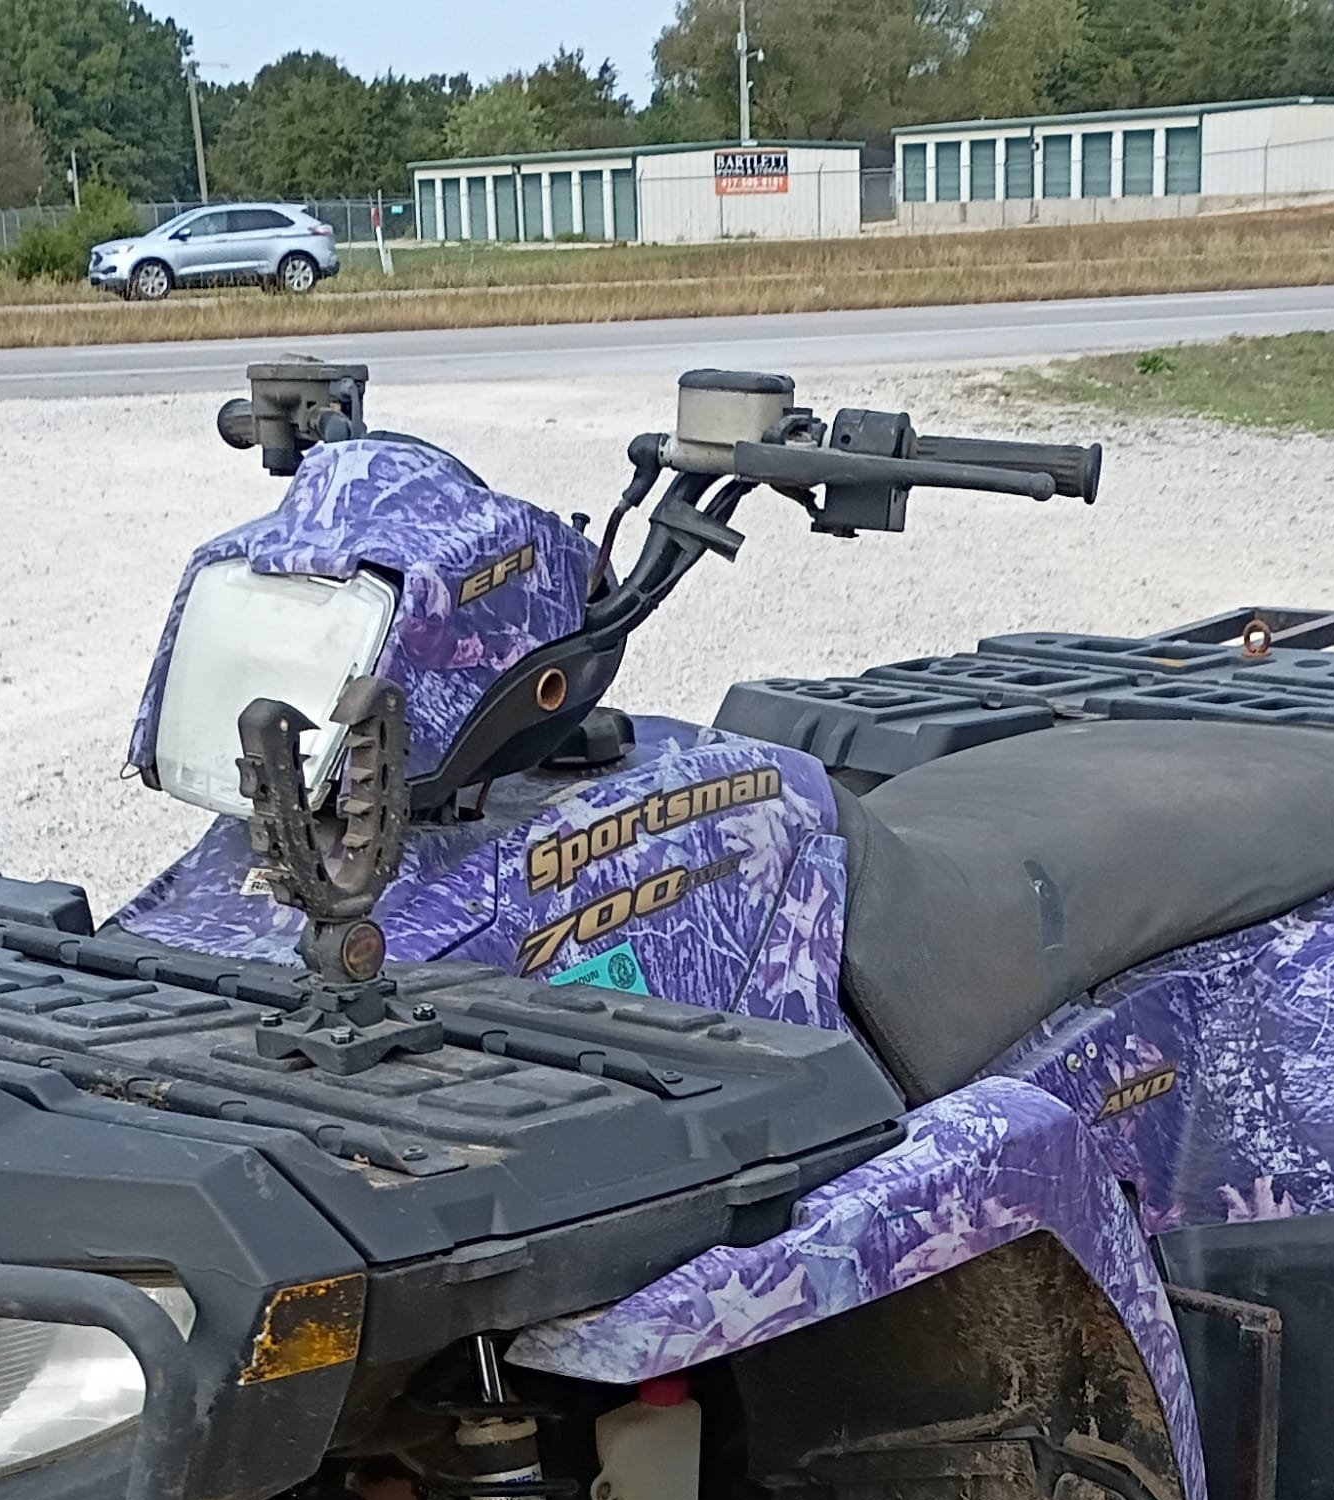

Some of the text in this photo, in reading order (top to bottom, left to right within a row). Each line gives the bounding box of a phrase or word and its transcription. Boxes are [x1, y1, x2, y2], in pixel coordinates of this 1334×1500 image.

[716, 154, 786, 168] BARTLETT
[459, 544, 534, 606] EFI
[529, 768, 780, 892] Sportsman
[520, 868, 688, 974] 700
[1094, 1071, 1176, 1121] AWD
